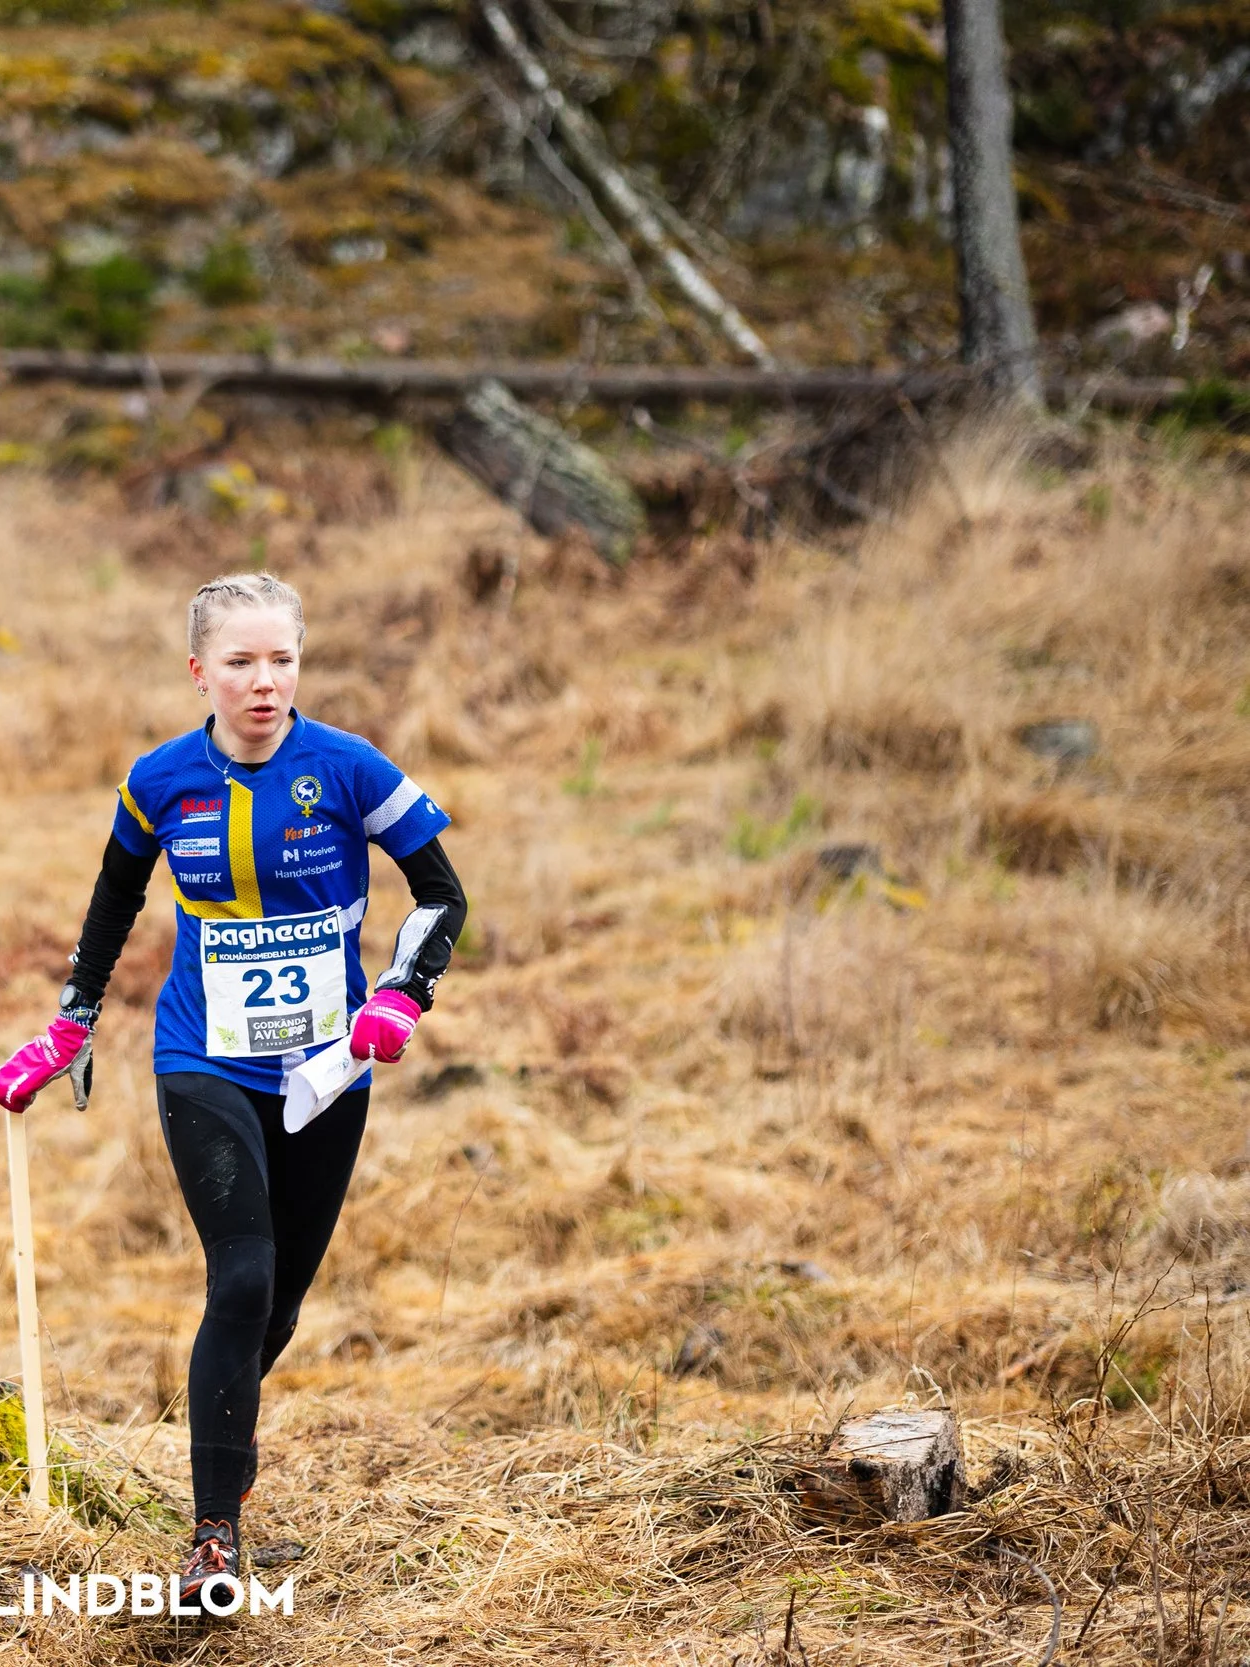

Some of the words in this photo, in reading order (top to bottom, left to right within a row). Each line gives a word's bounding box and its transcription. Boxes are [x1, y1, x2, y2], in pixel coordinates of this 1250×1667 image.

[303, 845, 337, 858] Moelven
[274, 859, 343, 879] Handelsbanken
[179, 872, 222, 884] TRIMTEX
[204, 915, 339, 950] bagheera
[219, 950, 287, 961] KOLMÅRDSMEDELN
[287, 949, 298, 957] SL
[298, 947, 309, 956] #2
[310, 944, 327, 954] 2026
[242, 965, 311, 1008] 23
[253, 1016, 308, 1030] GODKÄNDA
[254, 1024, 307, 1041] AVLOPP
